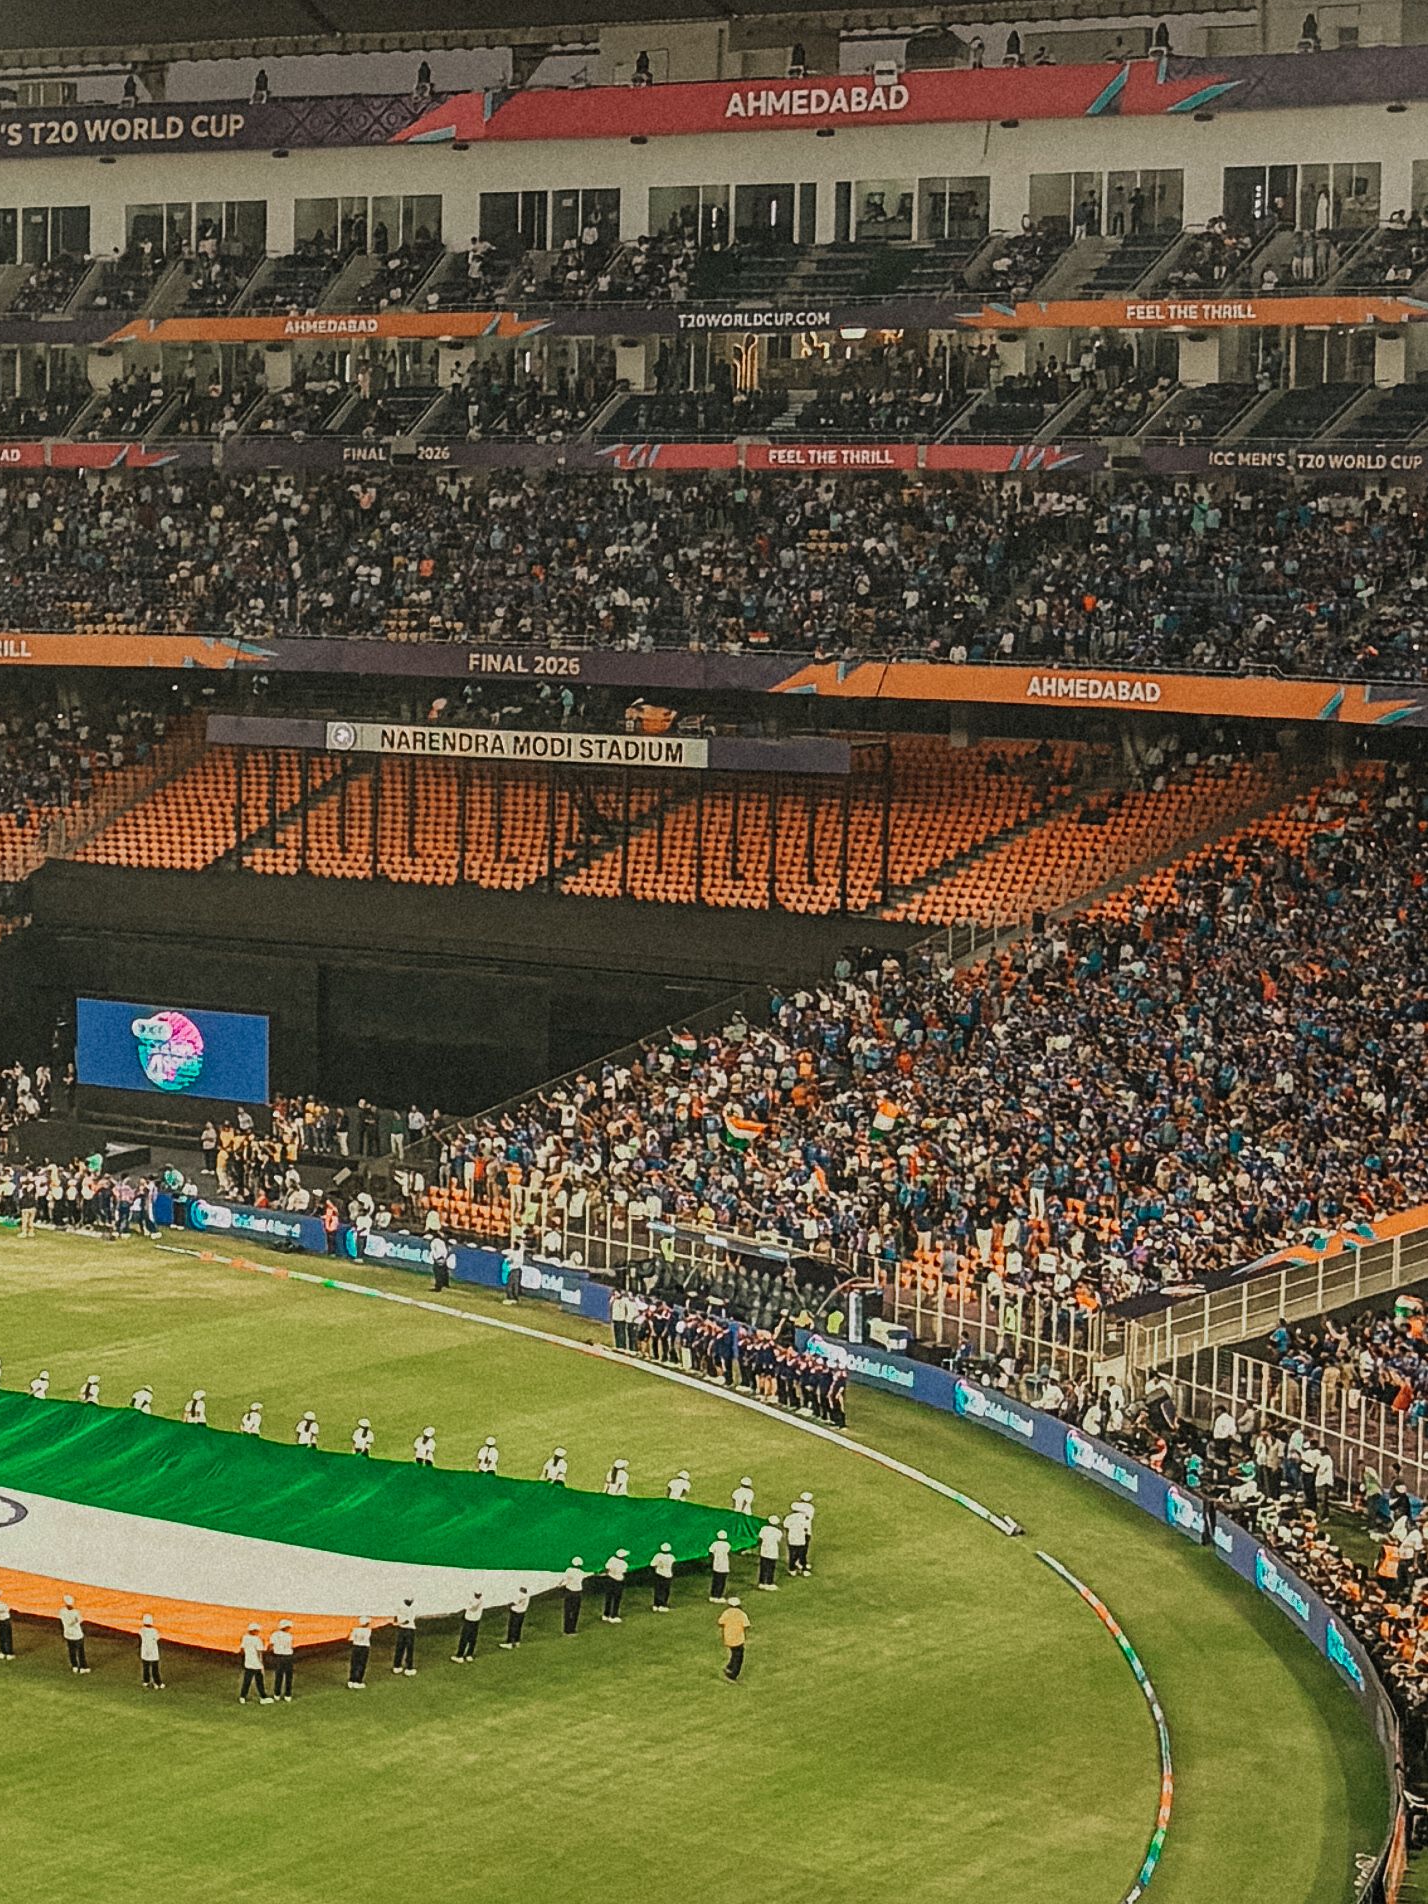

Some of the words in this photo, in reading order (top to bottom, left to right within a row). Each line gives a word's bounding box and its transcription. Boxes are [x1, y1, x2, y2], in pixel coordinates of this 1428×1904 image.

[725, 85, 908, 118] AHMEDABAD
[28, 121, 78, 146] T20
[85, 117, 184, 143] WORLD
[191, 114, 244, 140] CUP
[678, 312, 831, 330] T20WORLDCUP.COM
[1126, 304, 1164, 321] FEEL
[1167, 304, 1196, 321] THE
[1198, 303, 1256, 321] THRILL
[284, 318, 378, 335] AHMEDABAD
[343, 447, 386, 461] FINAL
[417, 446, 451, 461] 2026
[768, 449, 805, 466] FEEL
[811, 449, 837, 466] THE
[841, 449, 894, 466] THRILL
[1297, 454, 1326, 469] T20
[1328, 454, 1386, 470] WORLD
[1390, 456, 1423, 471] CUP
[469, 652, 529, 674] FINAL
[534, 655, 581, 676] 2026
[1027, 675, 1161, 703] AHMEDABAD
[380, 728, 505, 757] NARENDRA
[513, 736, 572, 760] MODI
[579, 739, 684, 764] STADIUM
